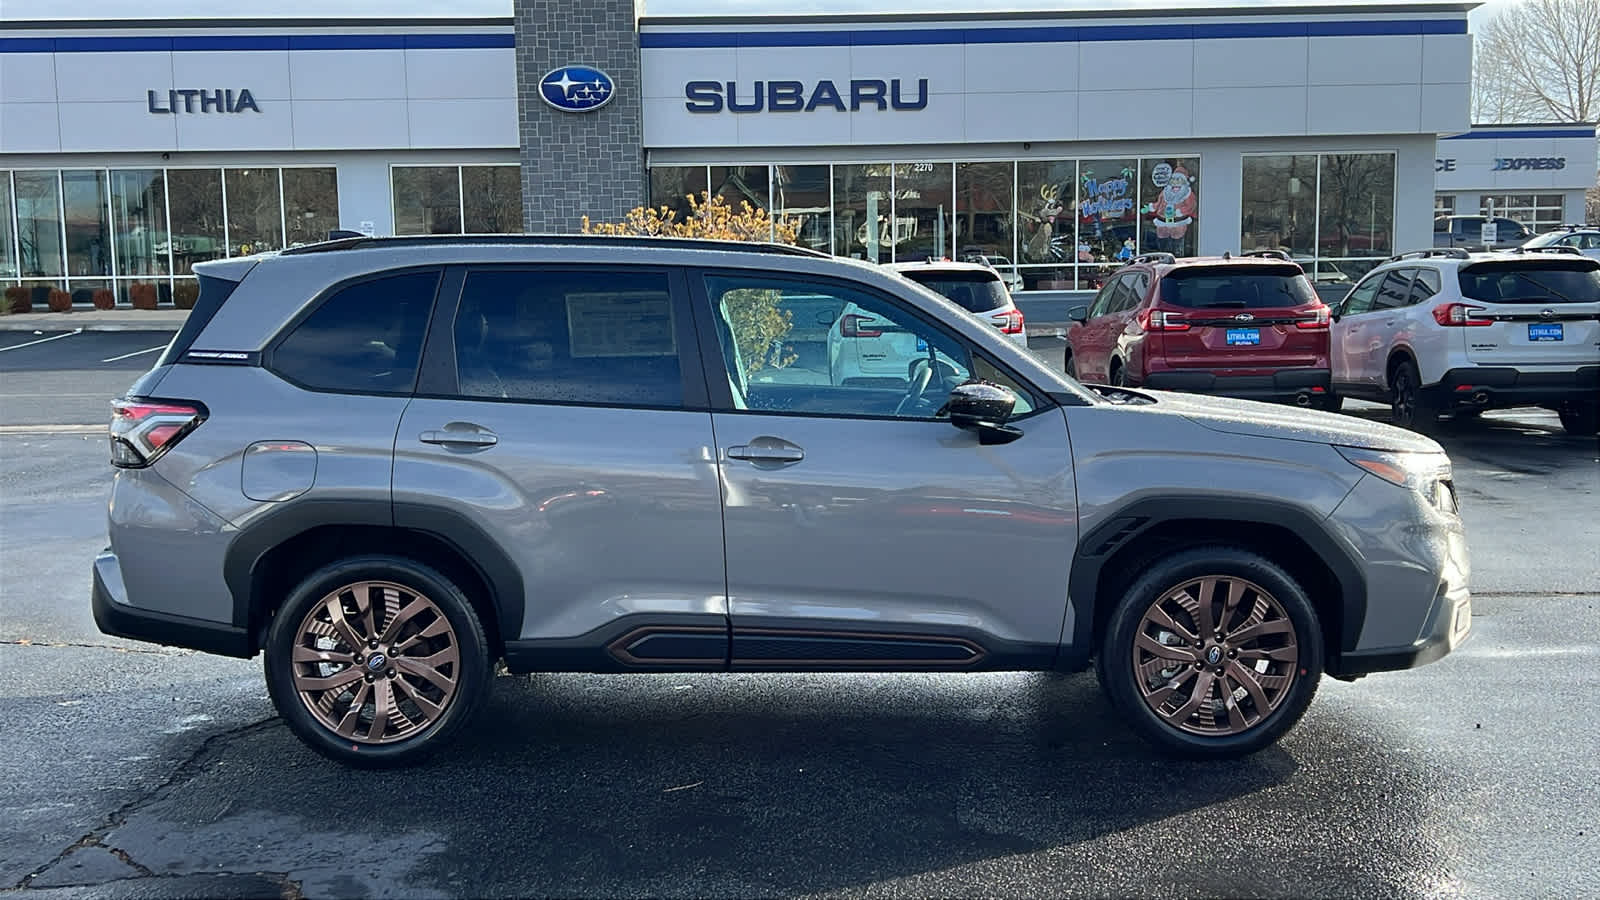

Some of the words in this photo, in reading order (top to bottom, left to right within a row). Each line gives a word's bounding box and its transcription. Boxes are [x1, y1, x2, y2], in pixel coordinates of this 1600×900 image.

[147, 88, 260, 114] LITHIA
[685, 79, 928, 113] SUBARU
[914, 163, 933, 172] 2270
[1498, 157, 1566, 171] EXPRESS
[1227, 333, 1259, 341] LITHIA.COM
